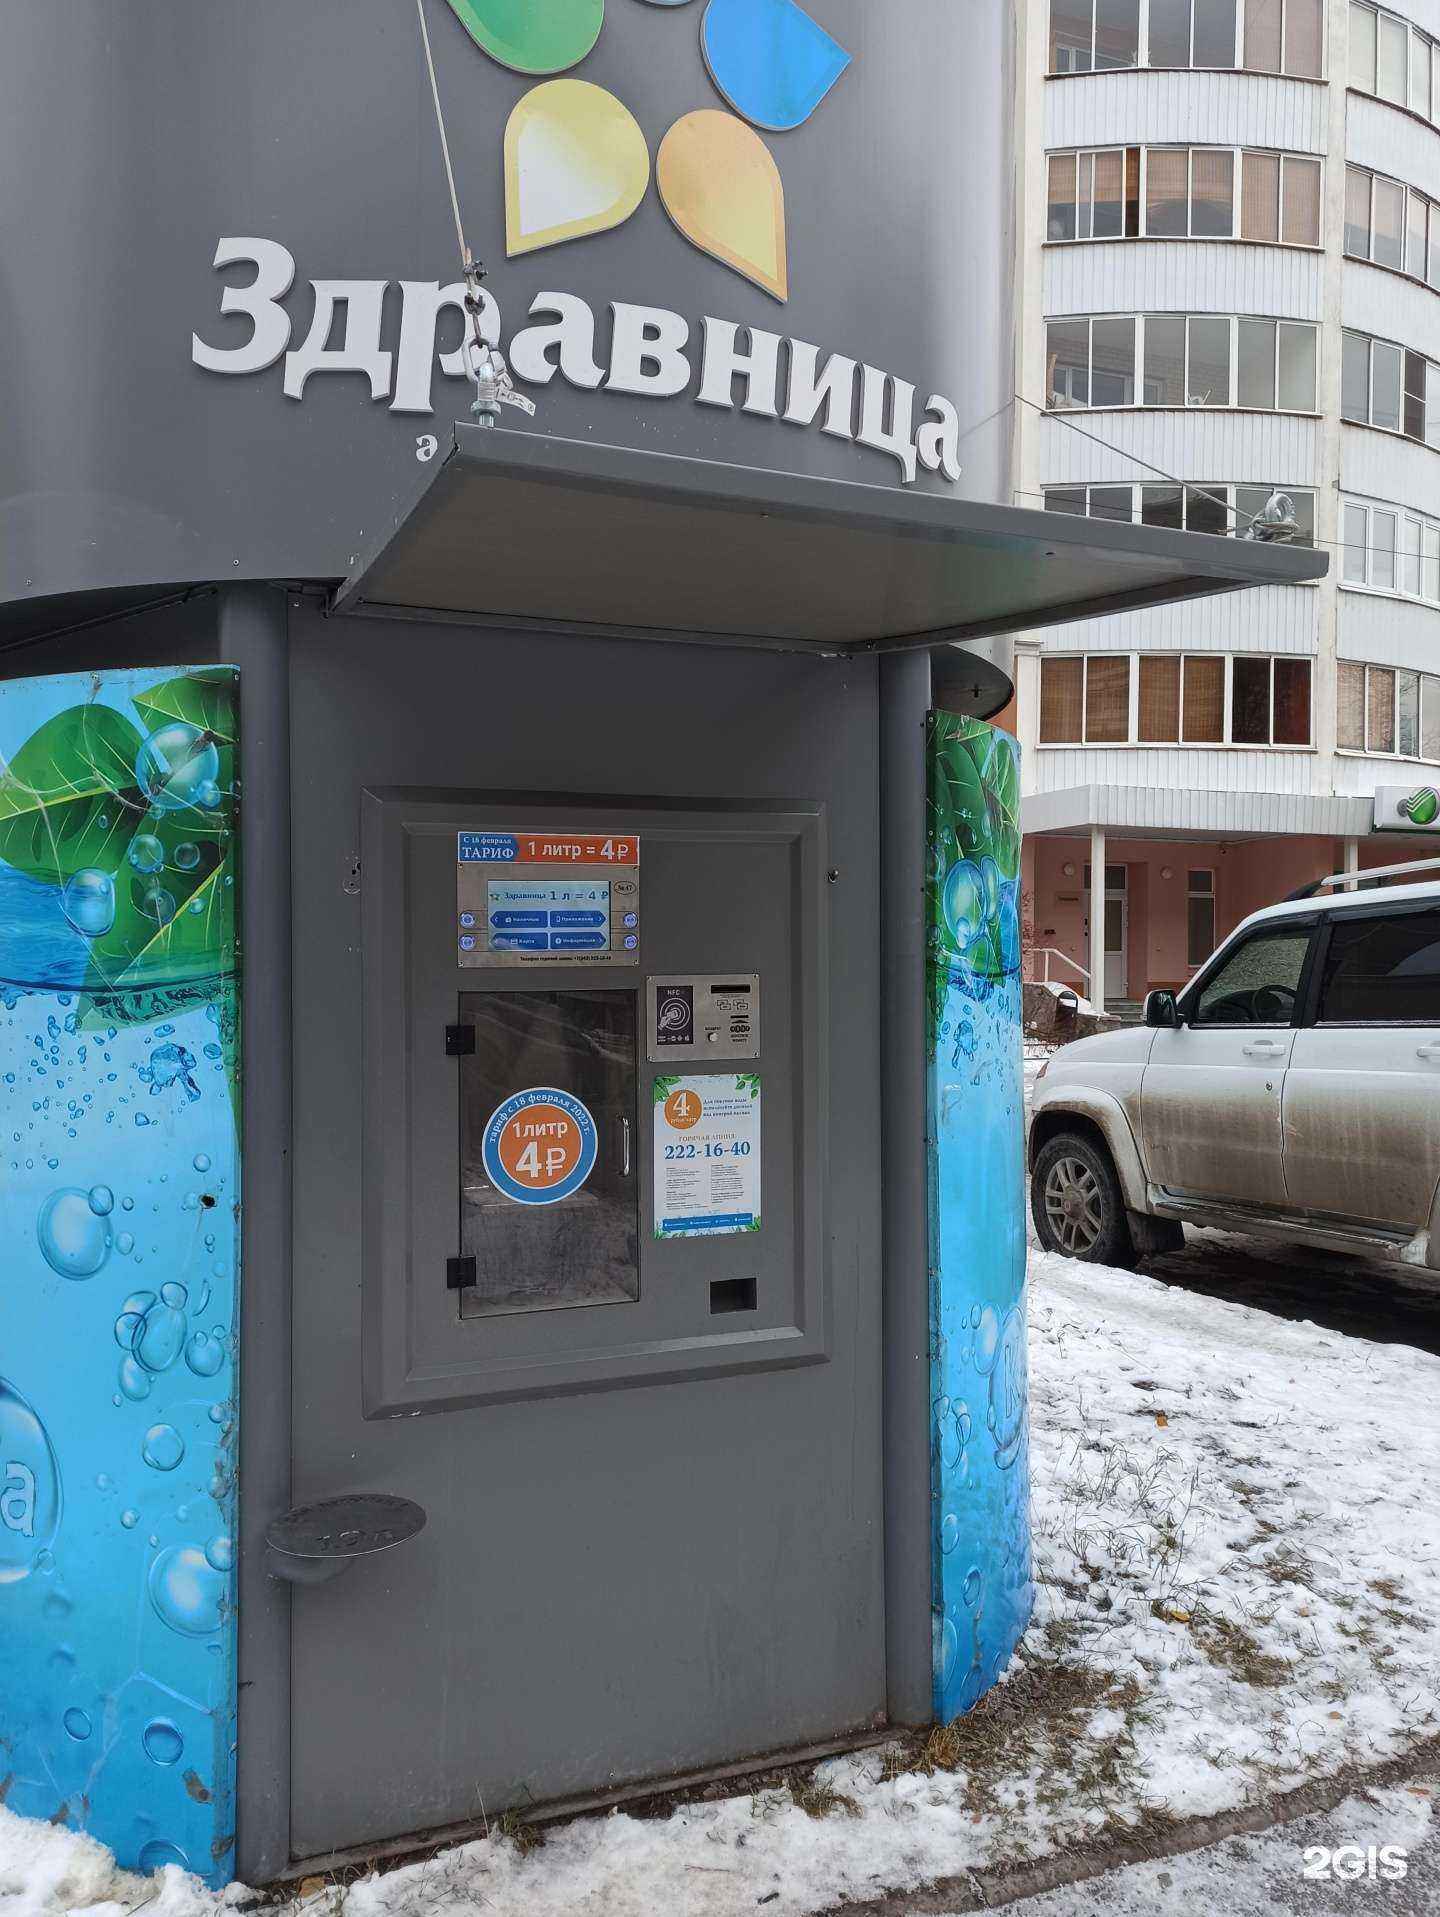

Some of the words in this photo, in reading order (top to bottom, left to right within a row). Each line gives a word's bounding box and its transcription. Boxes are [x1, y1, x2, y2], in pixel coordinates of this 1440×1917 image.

[192, 236, 963, 485] Здравница
[480, 837, 512, 845] февраля
[528, 841, 536, 856] 1
[542, 843, 582, 860] литр
[462, 847, 514, 859] ТАРИФ
[504, 892, 546, 901] Здравница
[550, 891, 557, 900] 1
[562, 892, 570, 900] л
[588, 891, 596, 900] 4
[489, 1113, 509, 1143] тариф
[515, 1097, 526, 1108] 18
[528, 1094, 571, 1107] февраля
[665, 1141, 751, 1160] 222-16-40
